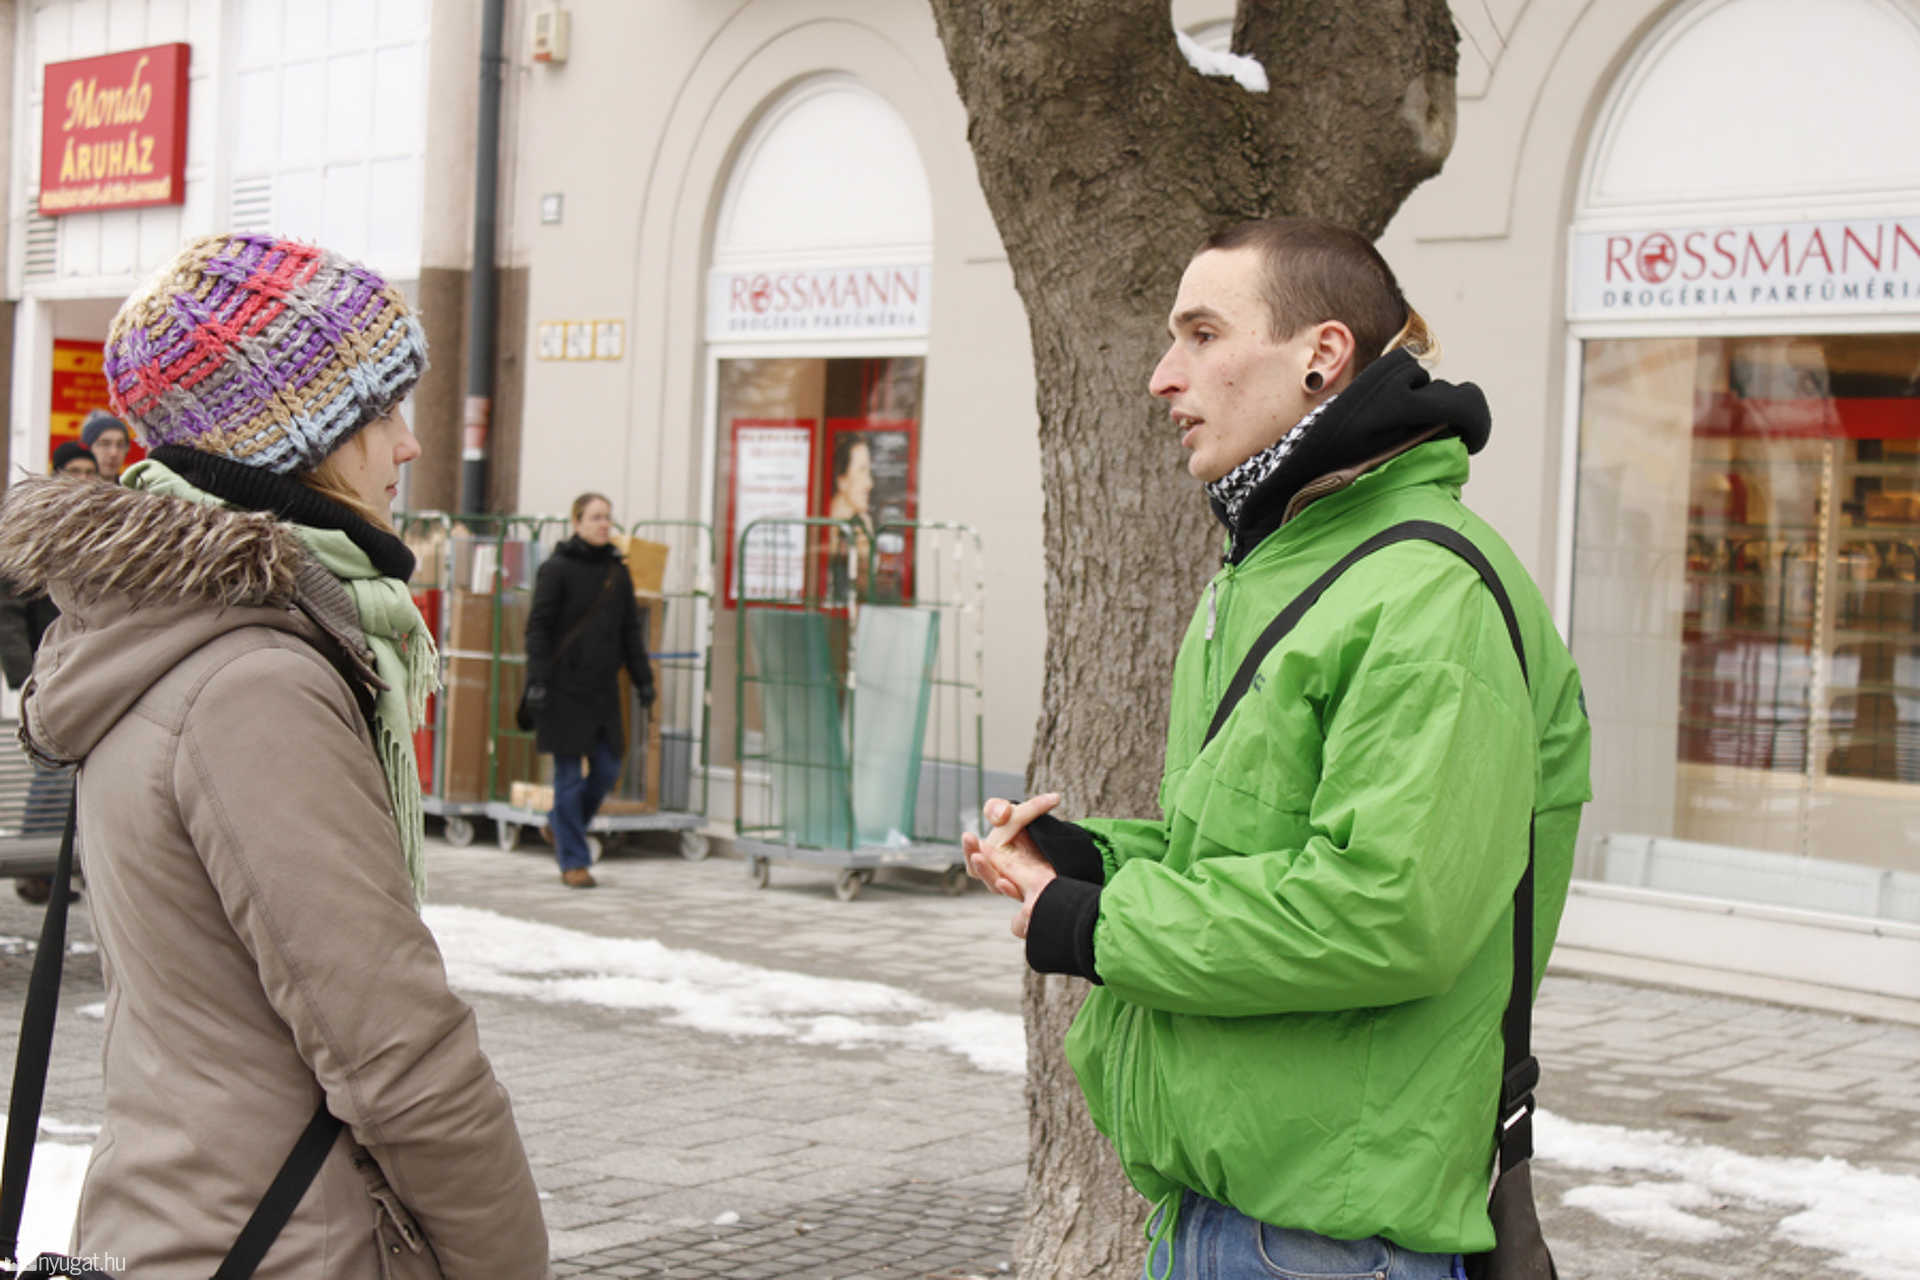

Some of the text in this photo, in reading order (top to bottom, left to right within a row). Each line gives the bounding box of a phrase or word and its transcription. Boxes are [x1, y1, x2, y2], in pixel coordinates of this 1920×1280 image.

[62, 56, 151, 130] Mondo
[60, 128, 155, 183] ÁRUHÁZ
[1604, 222, 1920, 284] ROSSMANN
[730, 268, 920, 313] ROSSMANN
[1602, 286, 1738, 308] DROGÉRIA
